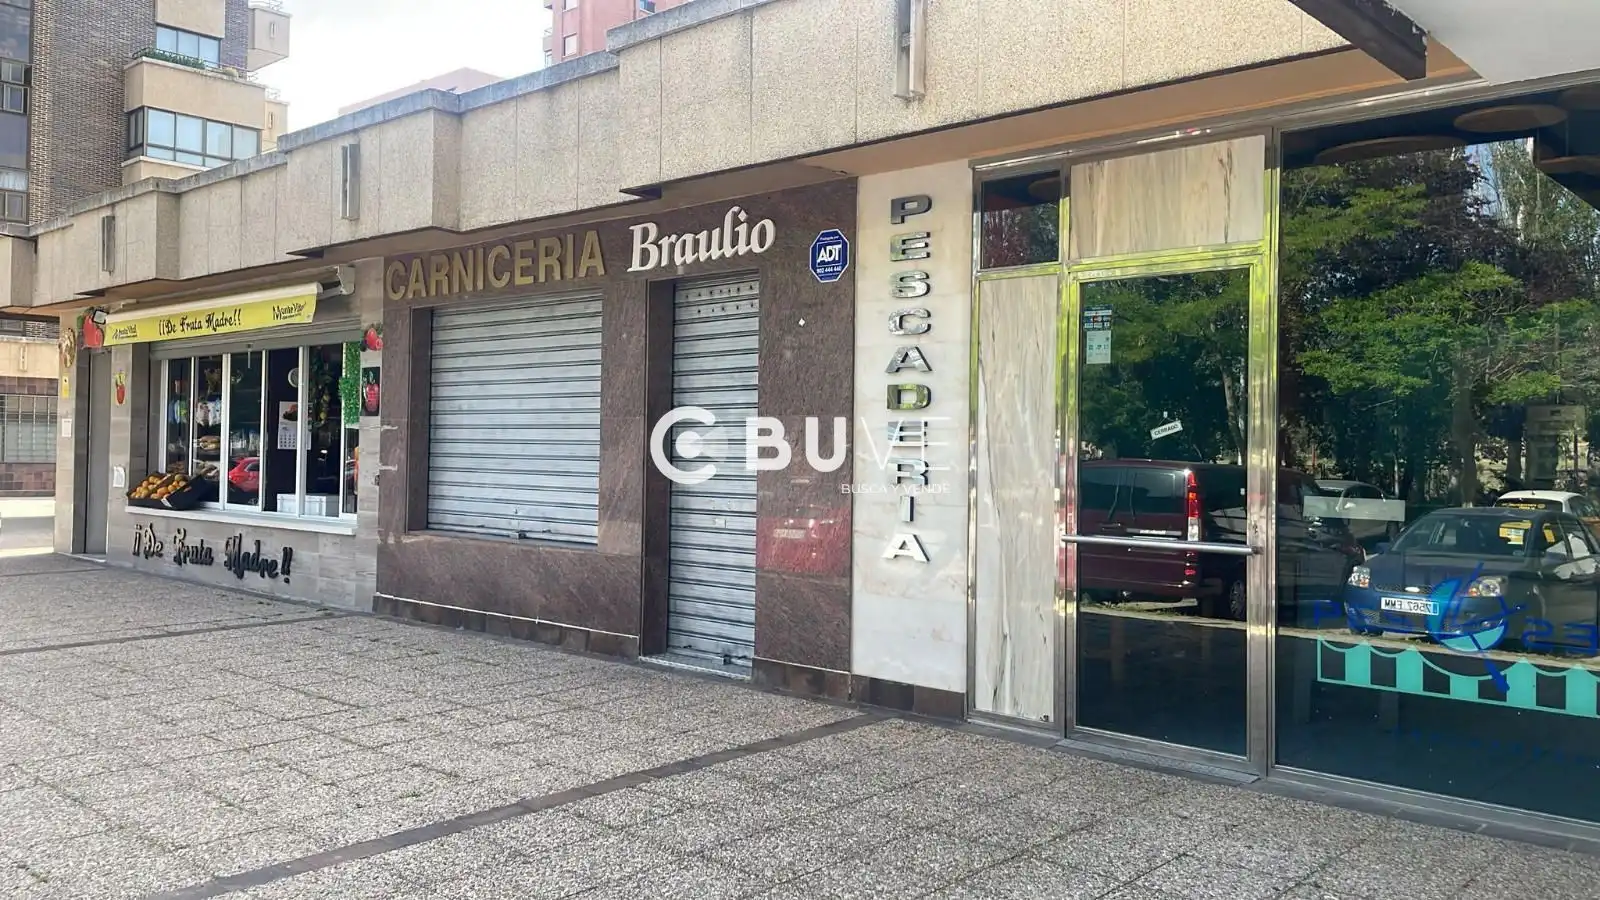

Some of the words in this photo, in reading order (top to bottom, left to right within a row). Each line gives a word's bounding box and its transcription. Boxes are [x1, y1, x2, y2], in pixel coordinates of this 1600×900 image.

[385, 229, 607, 301] CARNICERIA
[626, 205, 776, 273] Braulio
[817, 244, 842, 262] ADT
[883, 195, 933, 563] PESCADERIA
